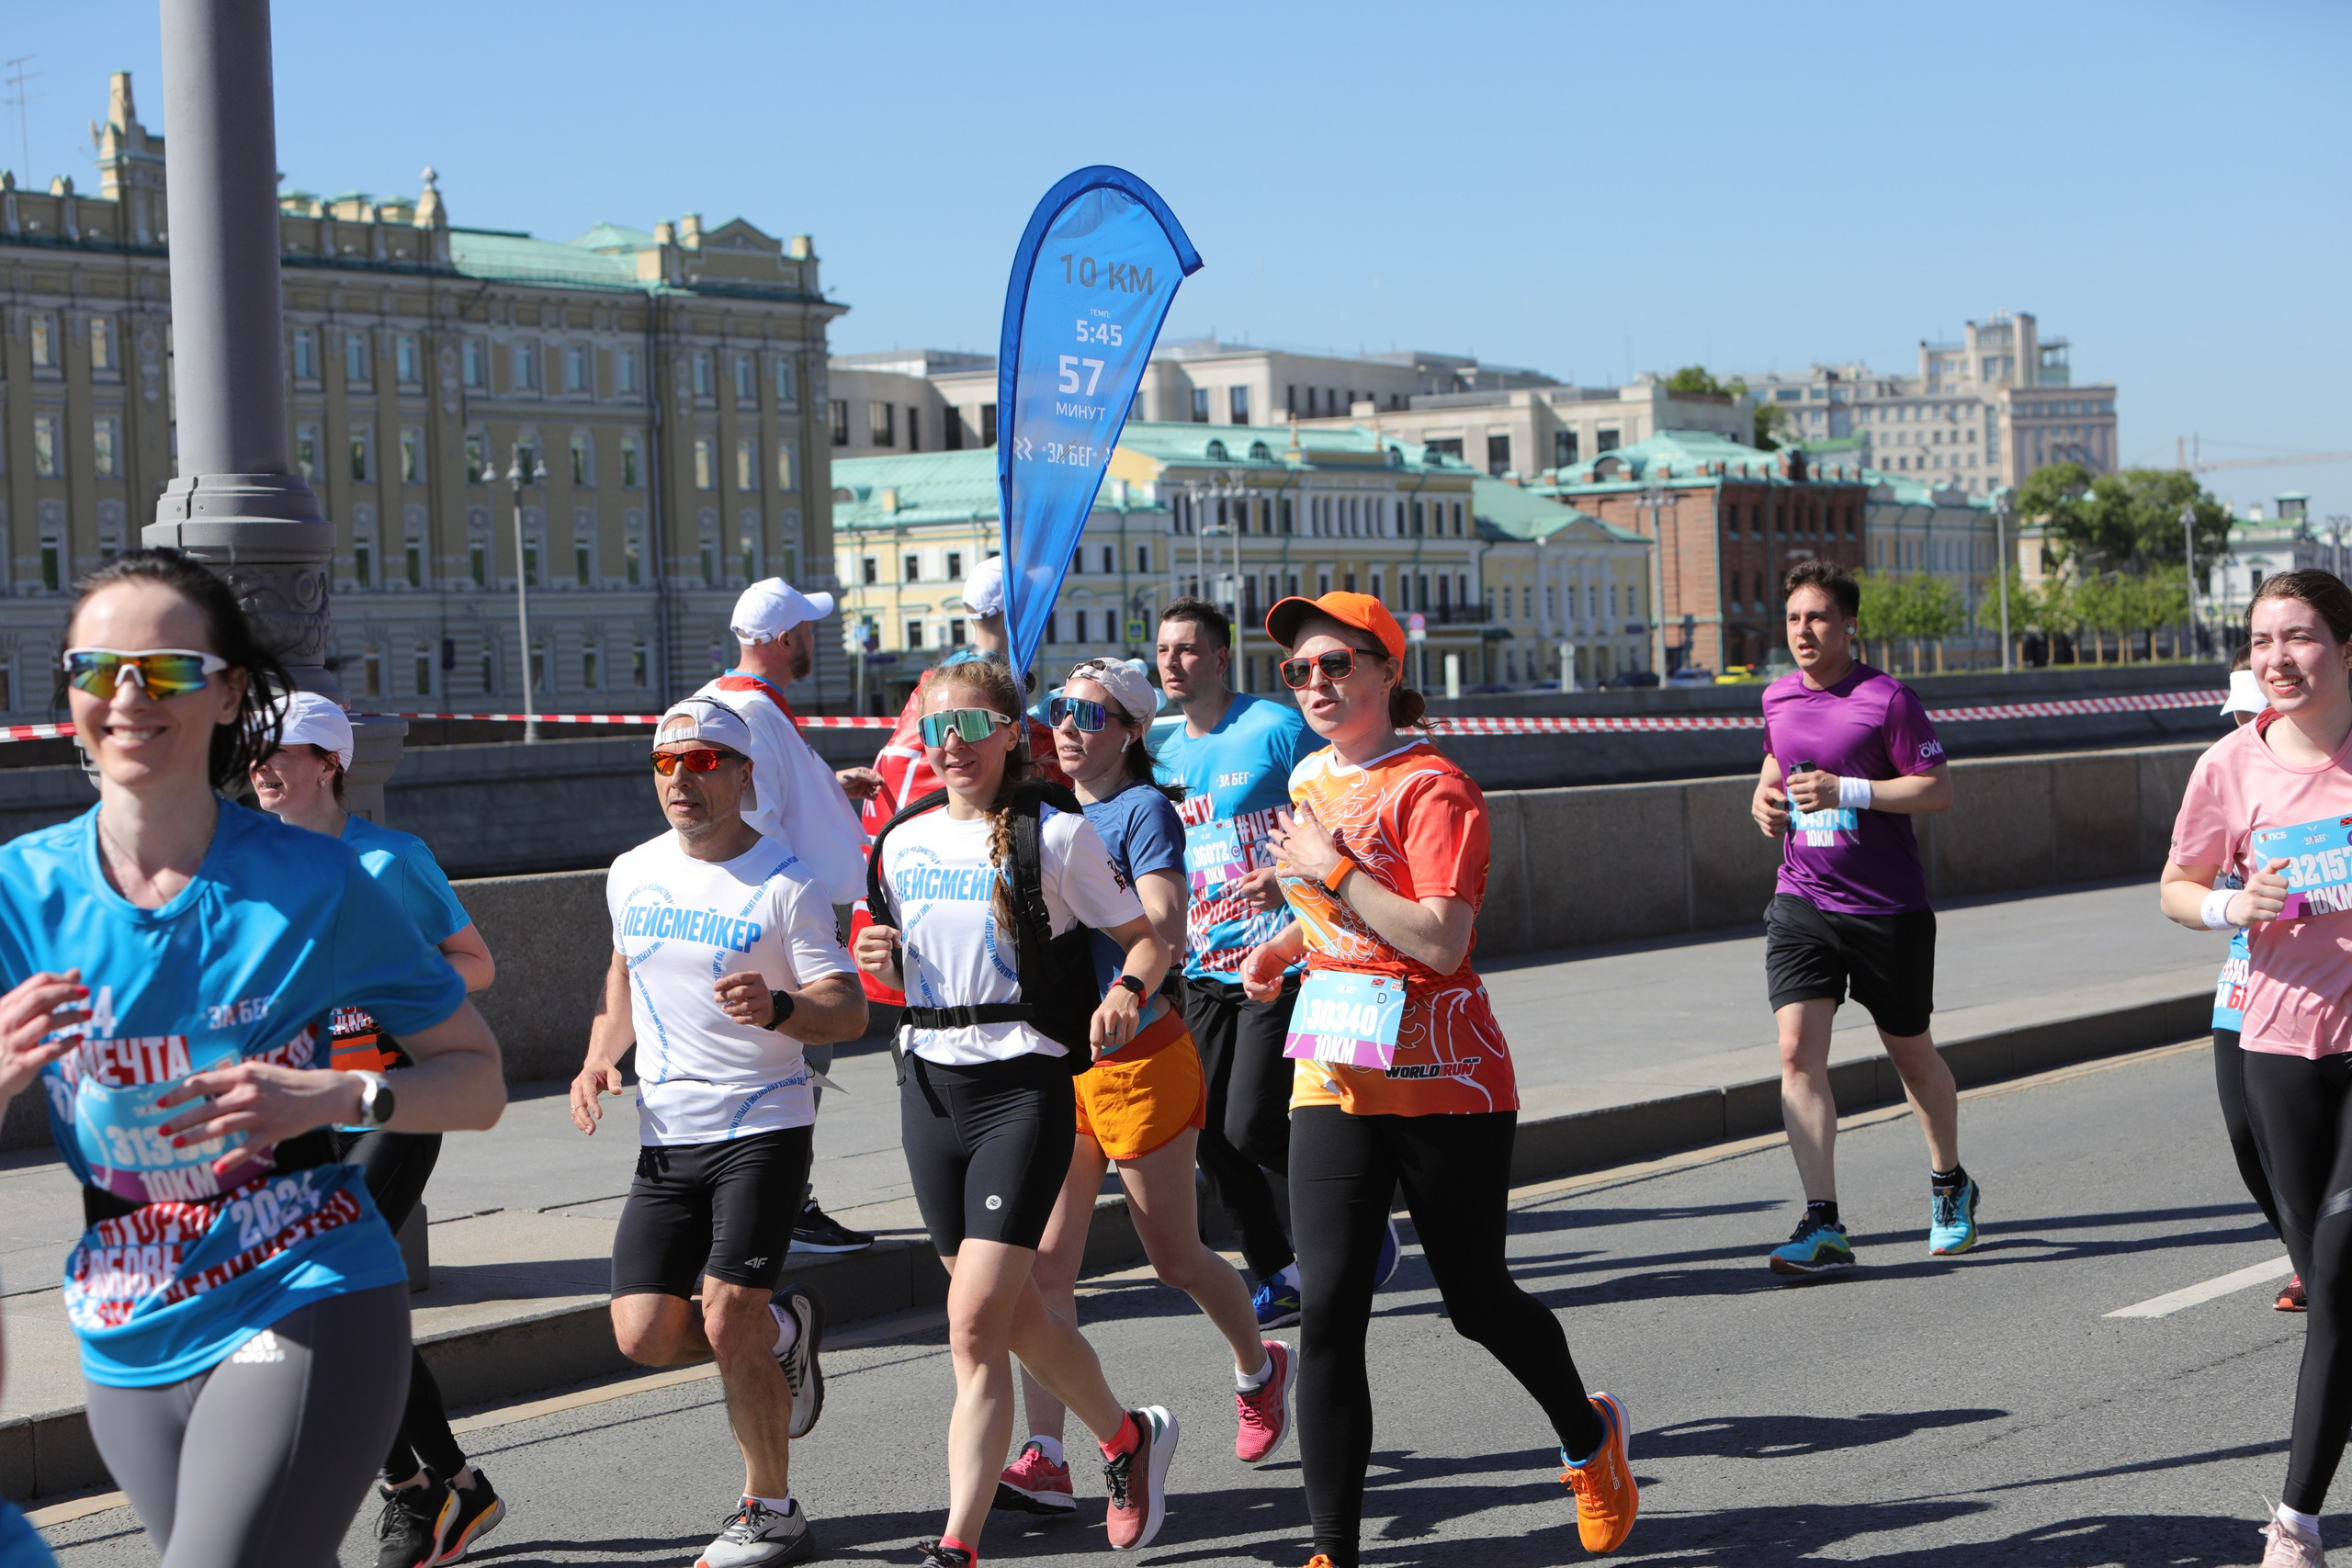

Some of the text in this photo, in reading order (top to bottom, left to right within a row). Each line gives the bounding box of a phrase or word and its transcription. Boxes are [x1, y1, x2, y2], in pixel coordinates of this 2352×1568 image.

[1060, 254, 1153, 296] 10 КМ
[1089, 308, 1111, 319] ТЕМП:
[1076, 319, 1123, 347] 5:45
[1058, 355, 1105, 397] 57
[1056, 401, 1106, 422] МИНУТ
[2268, 831, 2288, 840] ПСБ
[1193, 840, 1230, 868] 36072
[624, 902, 762, 953] ПЕЙСМЕЙКЕР
[1377, 992, 1387, 1004] D
[1306, 998, 1378, 1036] 30340
[1385, 1063, 1474, 1078] WORLD RUN
